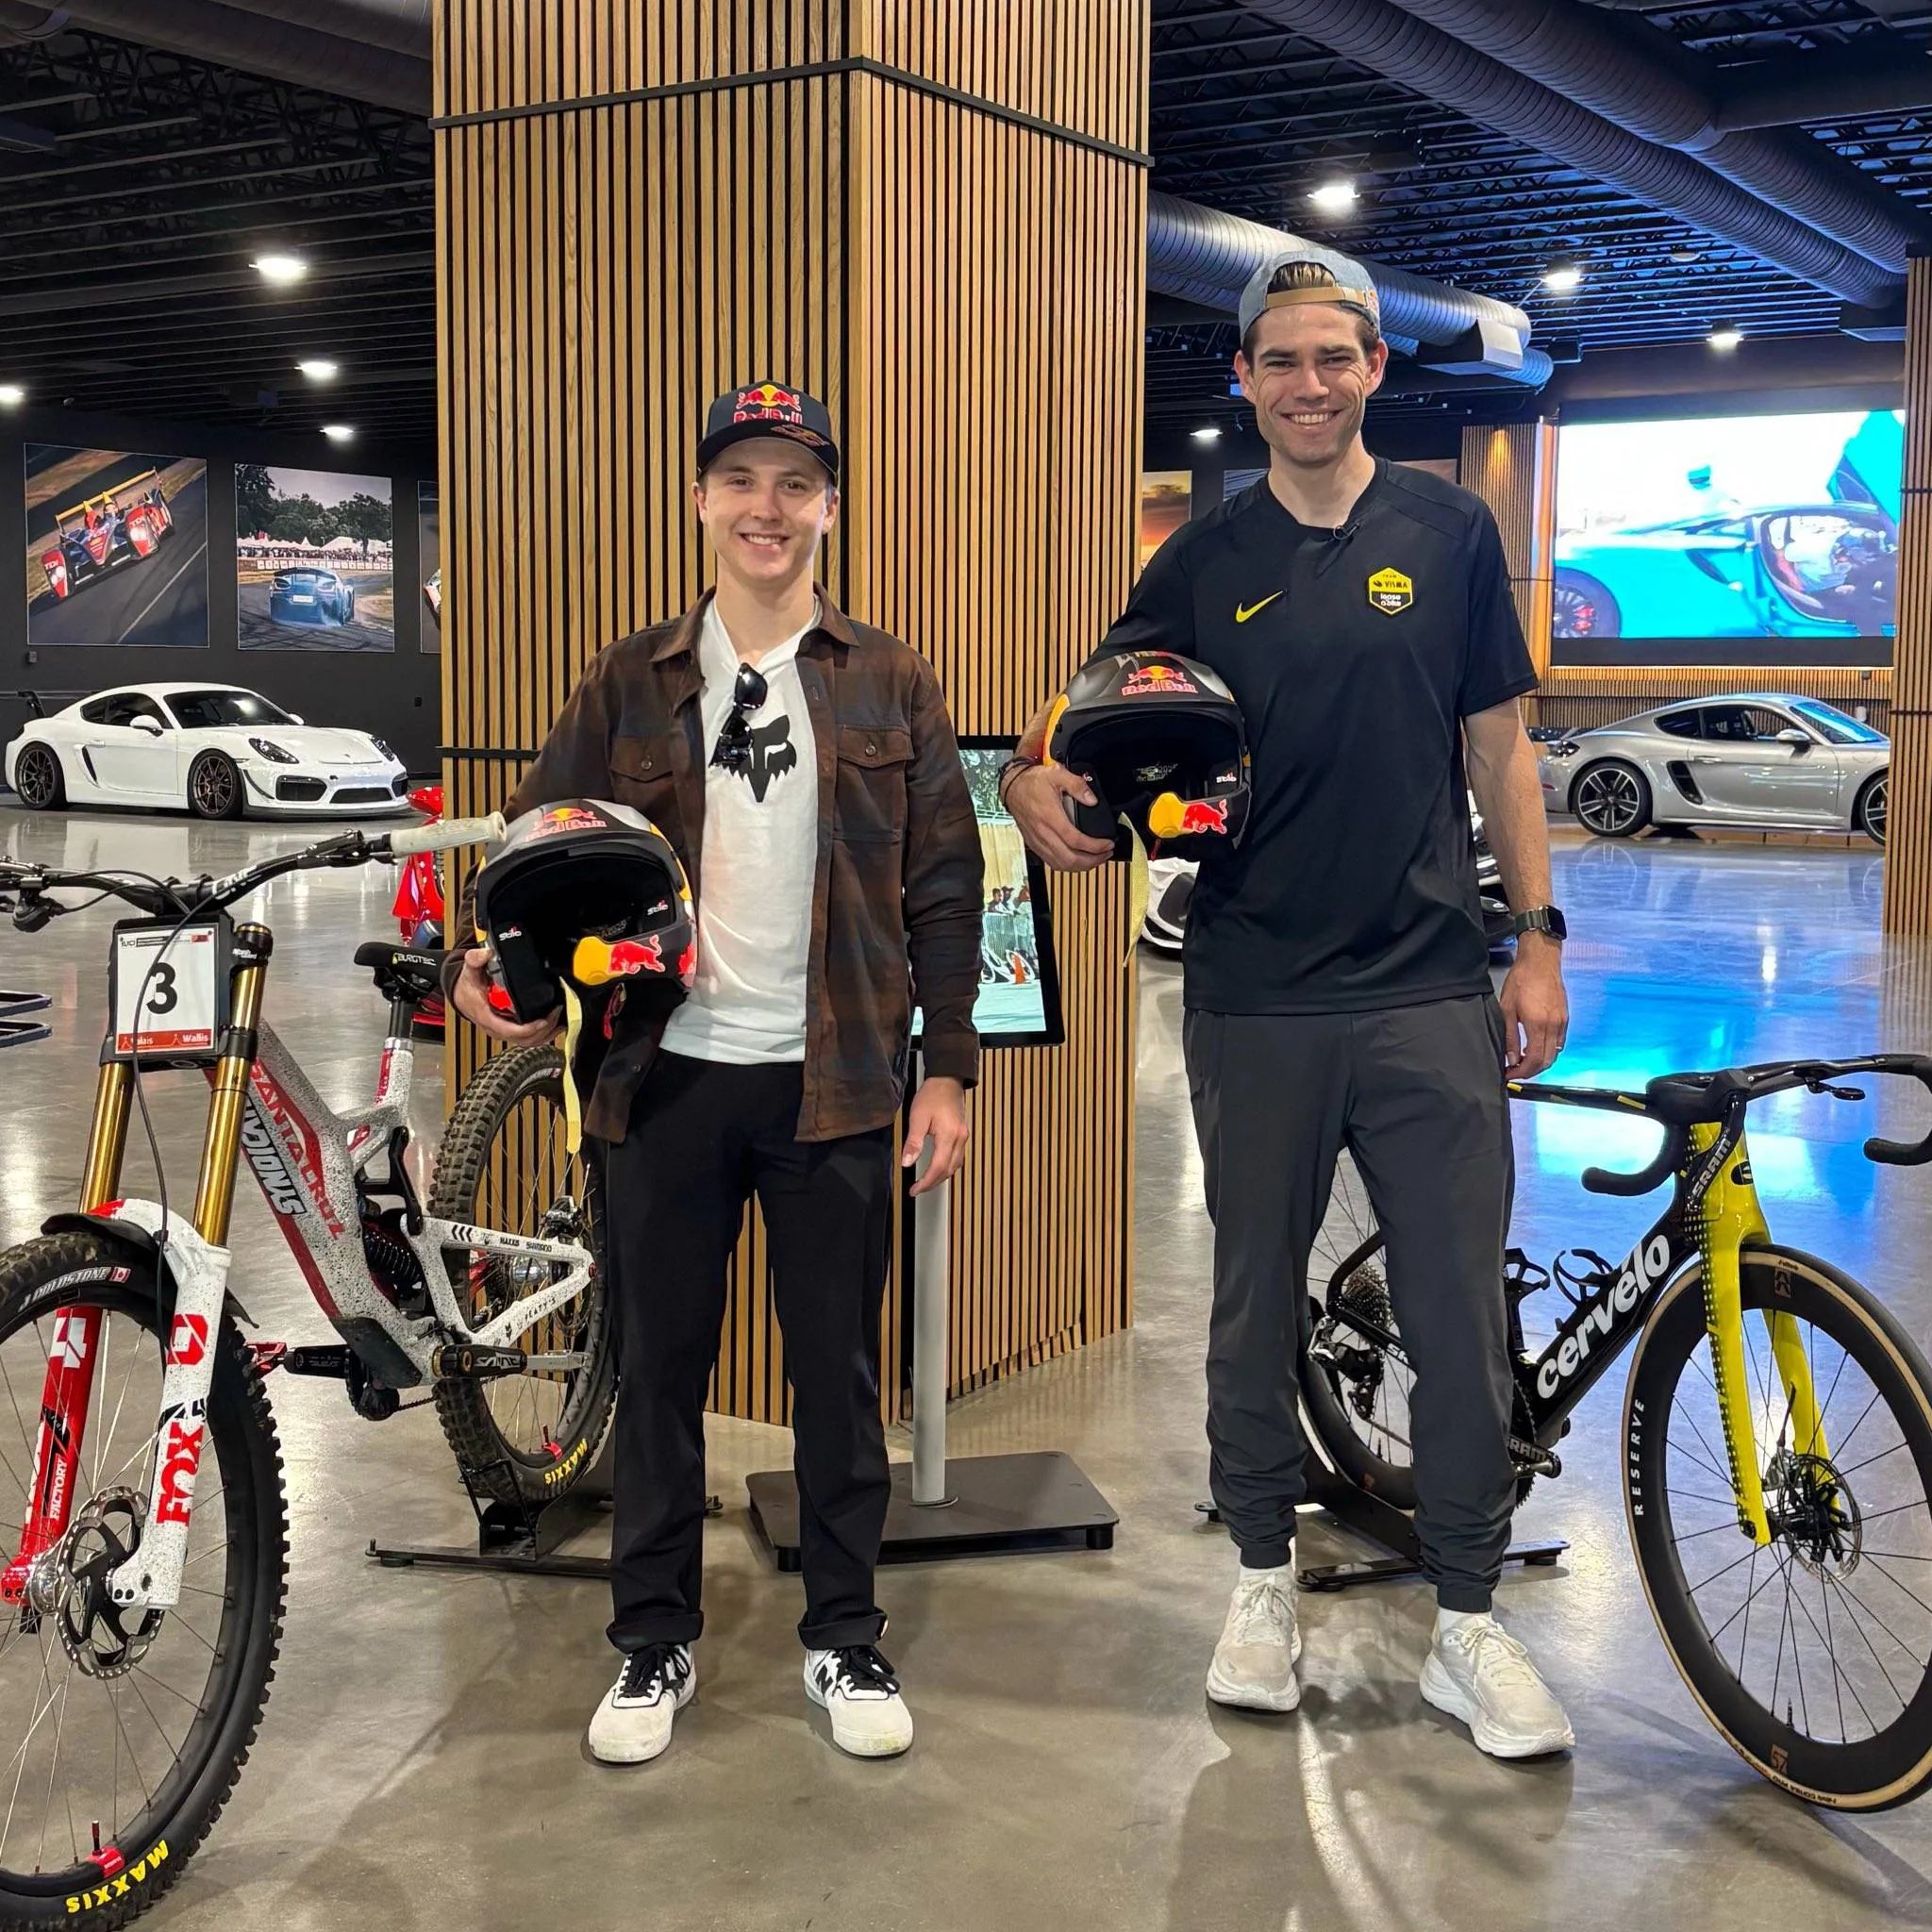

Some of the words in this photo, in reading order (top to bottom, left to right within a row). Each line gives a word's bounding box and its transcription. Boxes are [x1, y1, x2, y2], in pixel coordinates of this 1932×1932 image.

[146, 962, 177, 1014] 3
[182, 1032, 208, 1043] Wallis
[1692, 1137, 1732, 1198] SRAM
[156, 1422, 205, 1527] FOX
[544, 1438, 588, 1485] MAXXIS
[1509, 1438, 1548, 1462] RAM
[1630, 1399, 1645, 1516] RESERVE
[49, 1458, 68, 1522] FACTORY
[66, 1840, 169, 1913] MAXXIS
